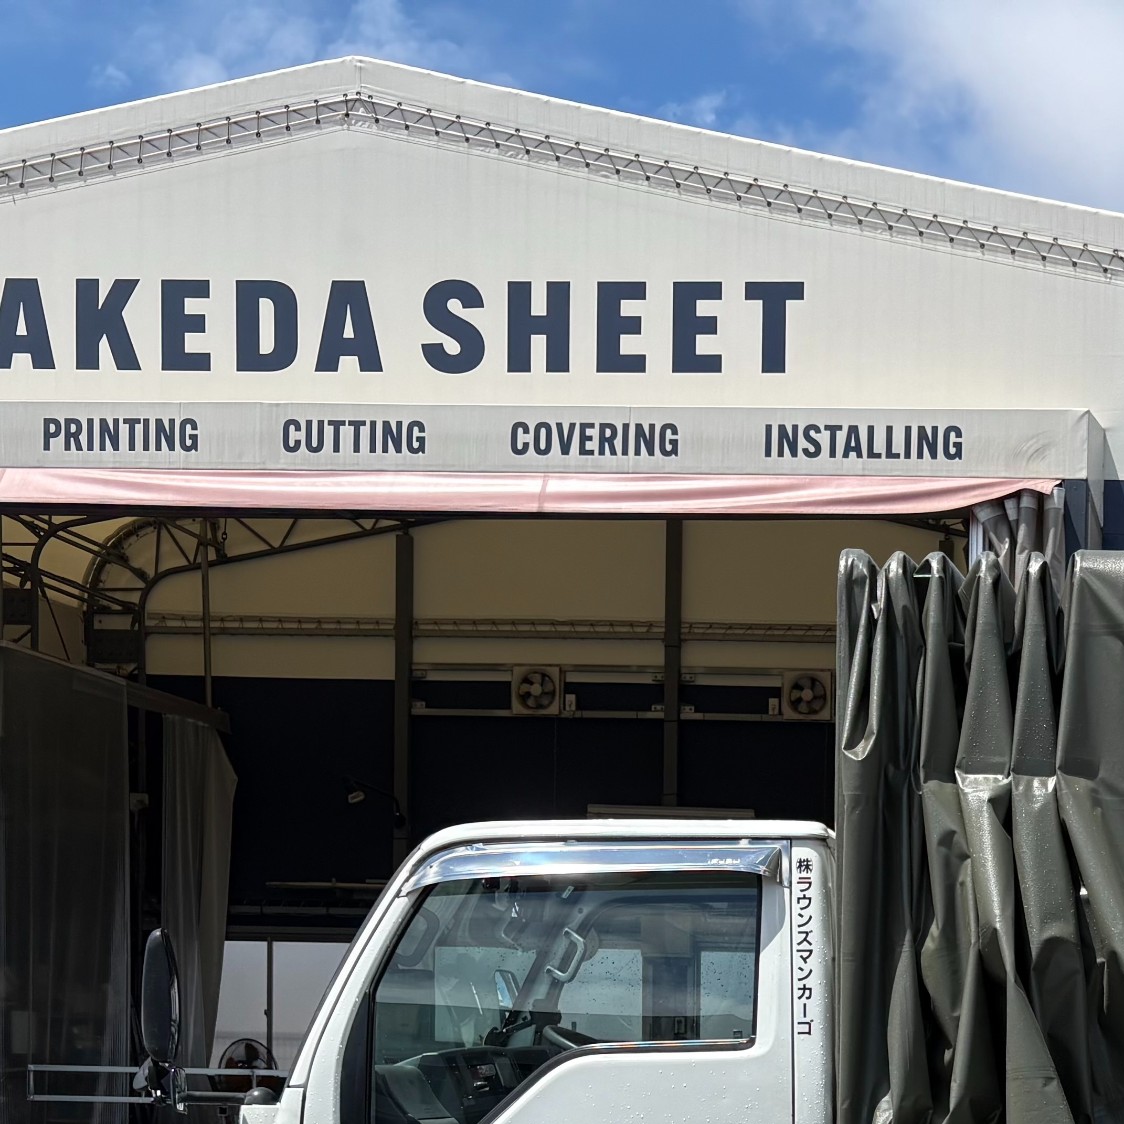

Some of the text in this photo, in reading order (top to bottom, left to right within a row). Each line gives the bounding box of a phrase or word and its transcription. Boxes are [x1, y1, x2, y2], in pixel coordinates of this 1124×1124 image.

[0, 277, 805, 375] AKEDA SHEET
[42, 417, 199, 453] PRINTING
[282, 418, 426, 455] CUTTING
[510, 421, 679, 457] COVERING
[764, 423, 963, 461] INSTALLING
